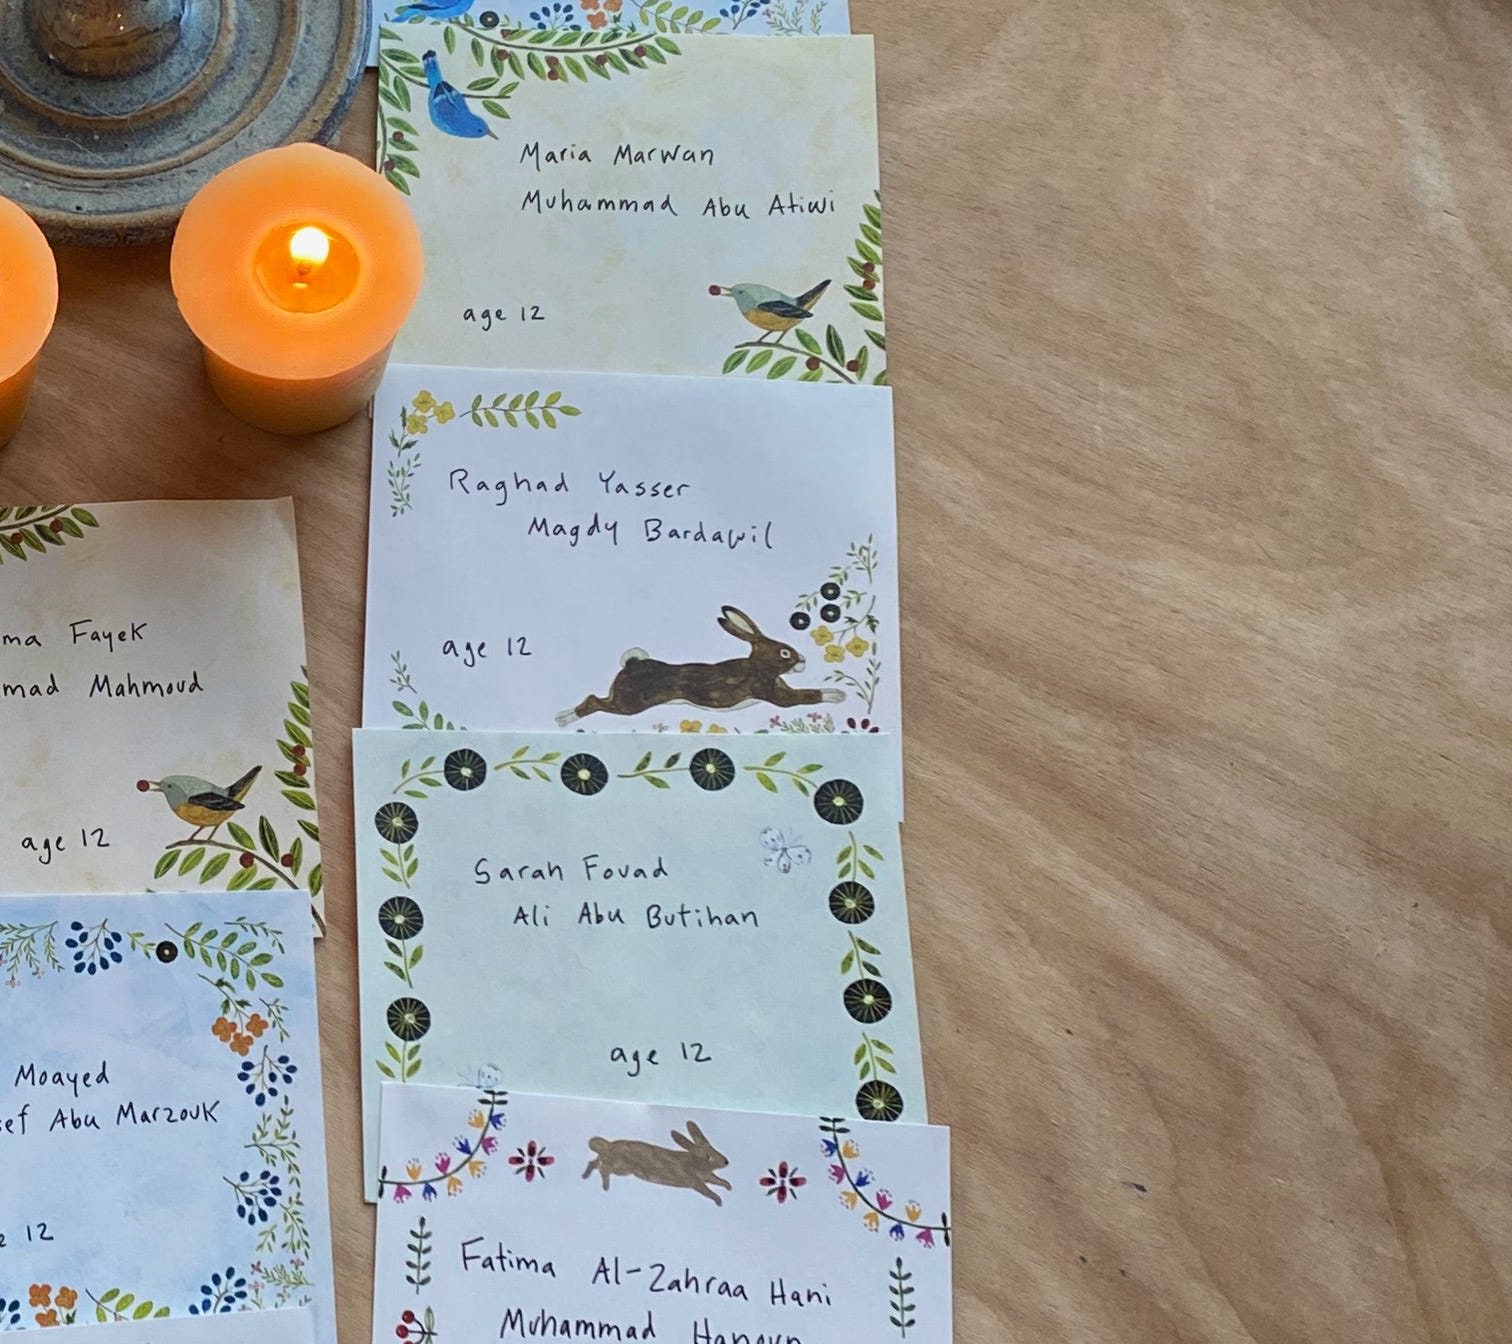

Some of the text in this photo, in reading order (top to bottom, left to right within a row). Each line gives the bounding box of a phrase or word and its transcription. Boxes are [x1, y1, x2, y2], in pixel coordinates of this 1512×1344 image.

[519, 141, 714, 173] Maria Marwan
[521, 188, 835, 220] Muhammad Abu Atiwi
[462, 305, 545, 332] age 12
[449, 468, 691, 507] Raghad Yasser
[527, 511, 773, 550] Magdy Bardawil
[68, 618, 148, 654] Fayek
[442, 636, 533, 668] age 12
[88, 670, 204, 698] Mahmoud
[21, 827, 111, 866] age 12
[474, 857, 564, 885] Sarah
[512, 901, 759, 930] Ali Abu Butihan
[610, 1041, 712, 1078] age 12
[14, 1059, 110, 1099] Moayed
[48, 1107, 101, 1133] Abu
[26, 1222, 55, 1243] 12
[460, 1235, 832, 1308] Fatima Al-Zahraa Hani
[499, 1307, 657, 1342] Muhammad
